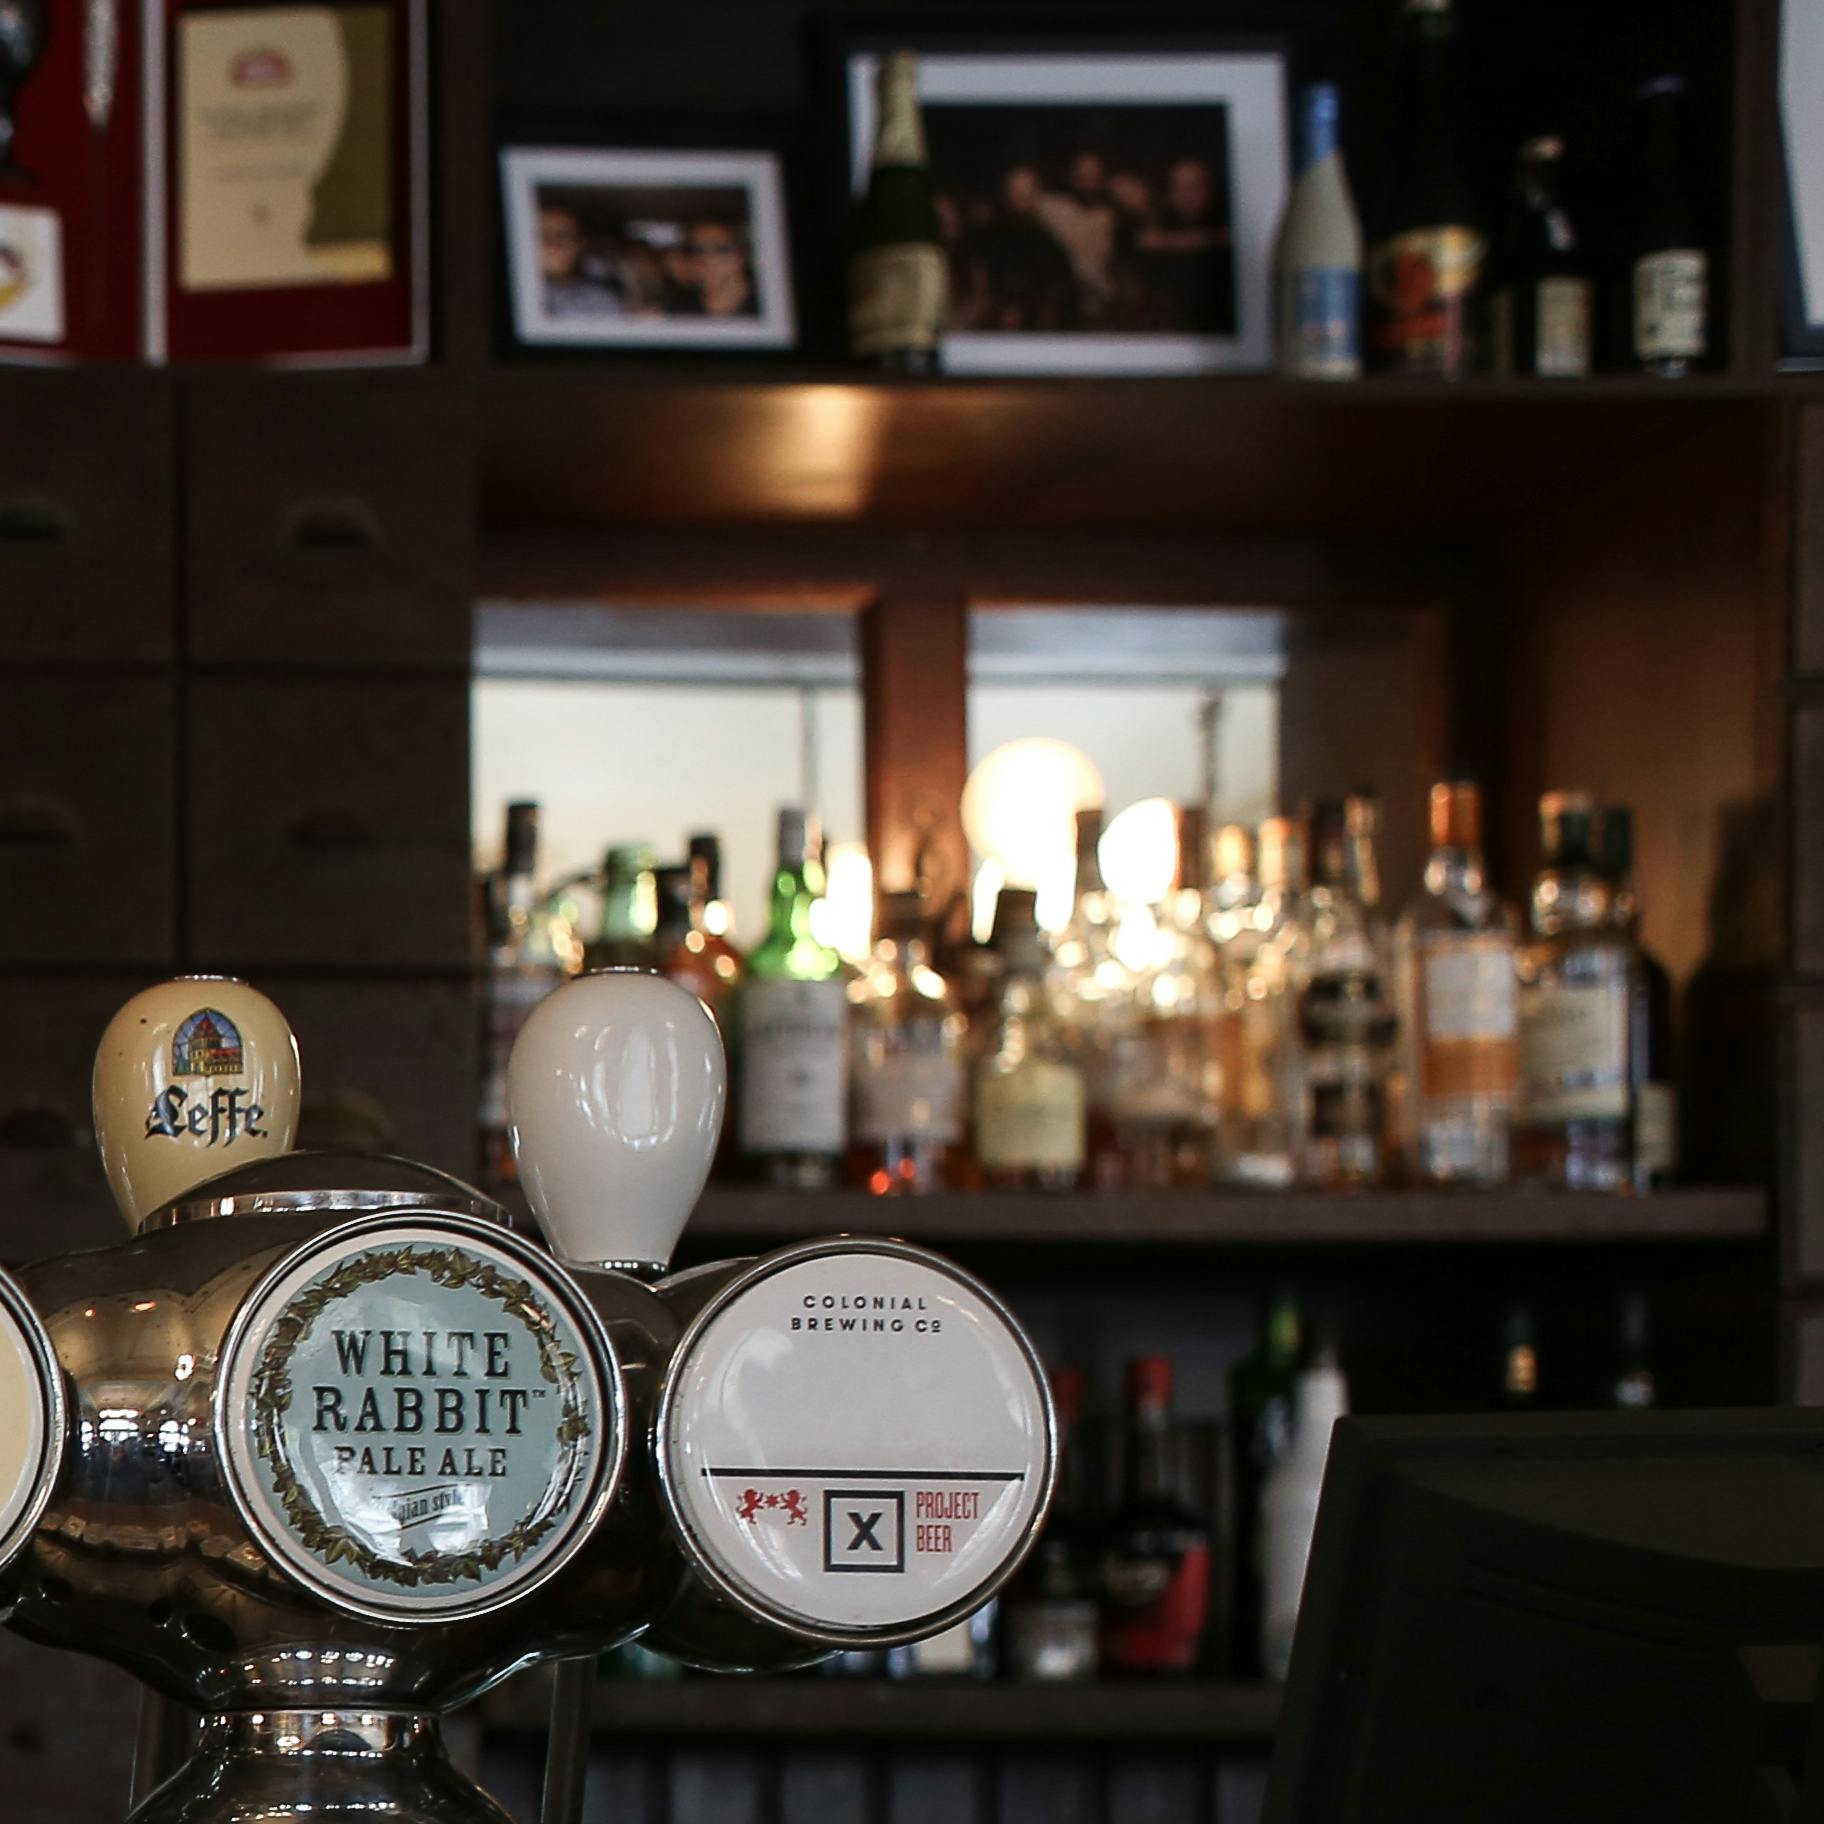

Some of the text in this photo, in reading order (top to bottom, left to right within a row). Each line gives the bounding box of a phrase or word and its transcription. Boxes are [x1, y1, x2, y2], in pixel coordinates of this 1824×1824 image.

[802, 1294, 928, 1311] COLONIAL
[791, 1317, 905, 1333] BREWING
[331, 1330, 511, 1378] WHITE
[312, 1386, 530, 1435] RABBIT
[334, 1446, 508, 1477] PALE ALE
[915, 1491, 980, 1519] PROJECT
[846, 1511, 884, 1552] X
[915, 1524, 953, 1553] BEER
